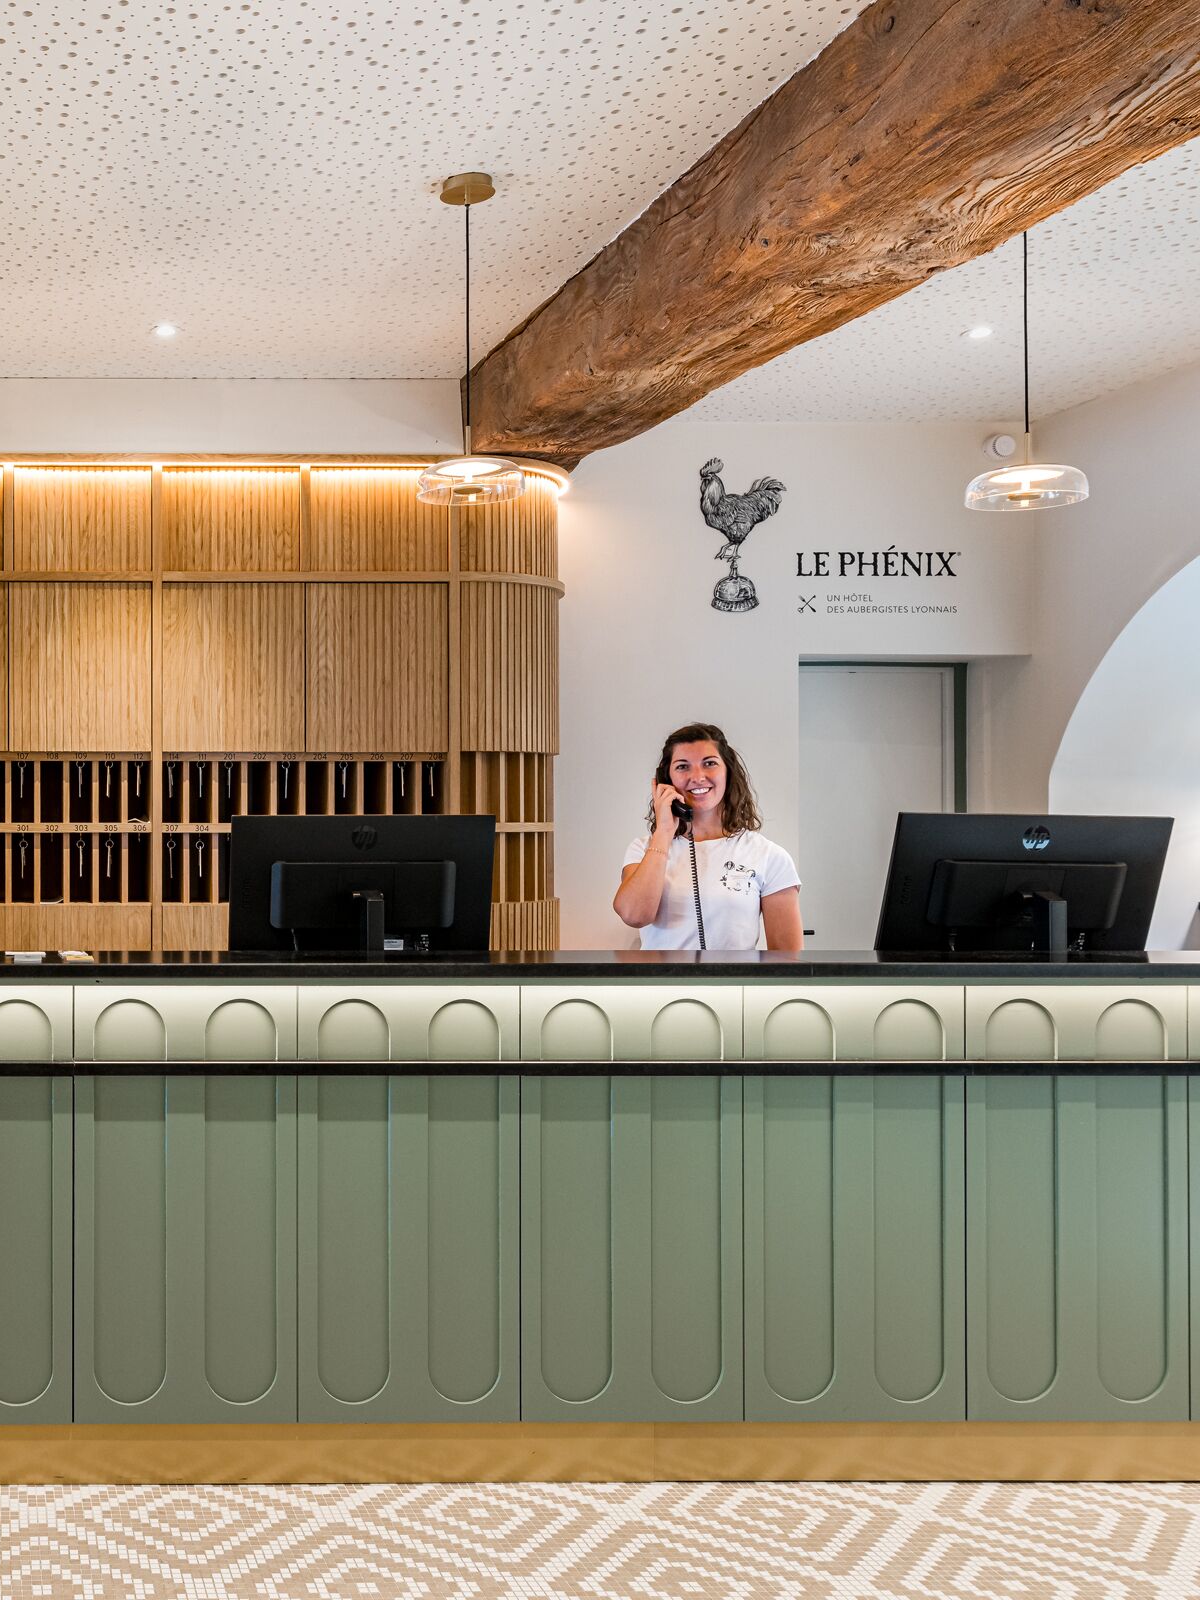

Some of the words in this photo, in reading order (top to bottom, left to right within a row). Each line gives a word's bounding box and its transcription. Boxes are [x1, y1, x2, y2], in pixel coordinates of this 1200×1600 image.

[796, 552, 830, 577] LE
[843, 592, 873, 602] HÔTEL
[826, 605, 845, 614] DES
[847, 605, 909, 614] AUBERGISTES
[911, 605, 958, 614] LYONNAIS
[16, 752, 29, 760] 107
[46, 752, 59, 760] 108
[75, 752, 87, 760] 109
[105, 752, 116, 760] 110
[133, 752, 144, 760] 112
[169, 752, 179, 760] 114
[198, 752, 207, 760] 111
[223, 752, 236, 760] 201
[252, 752, 267, 760] 202
[282, 752, 296, 760] 203
[313, 752, 327, 760] 204
[340, 752, 354, 760] 205
[370, 752, 385, 760] 206
[400, 752, 414, 760] 207
[429, 752, 443, 760] 208
[16, 824, 29, 832] 301
[45, 824, 59, 832] 302
[74, 824, 88, 832] 303
[104, 824, 118, 832] 305
[133, 824, 147, 832] 306
[165, 824, 179, 832] 307
[195, 824, 209, 832] 304
